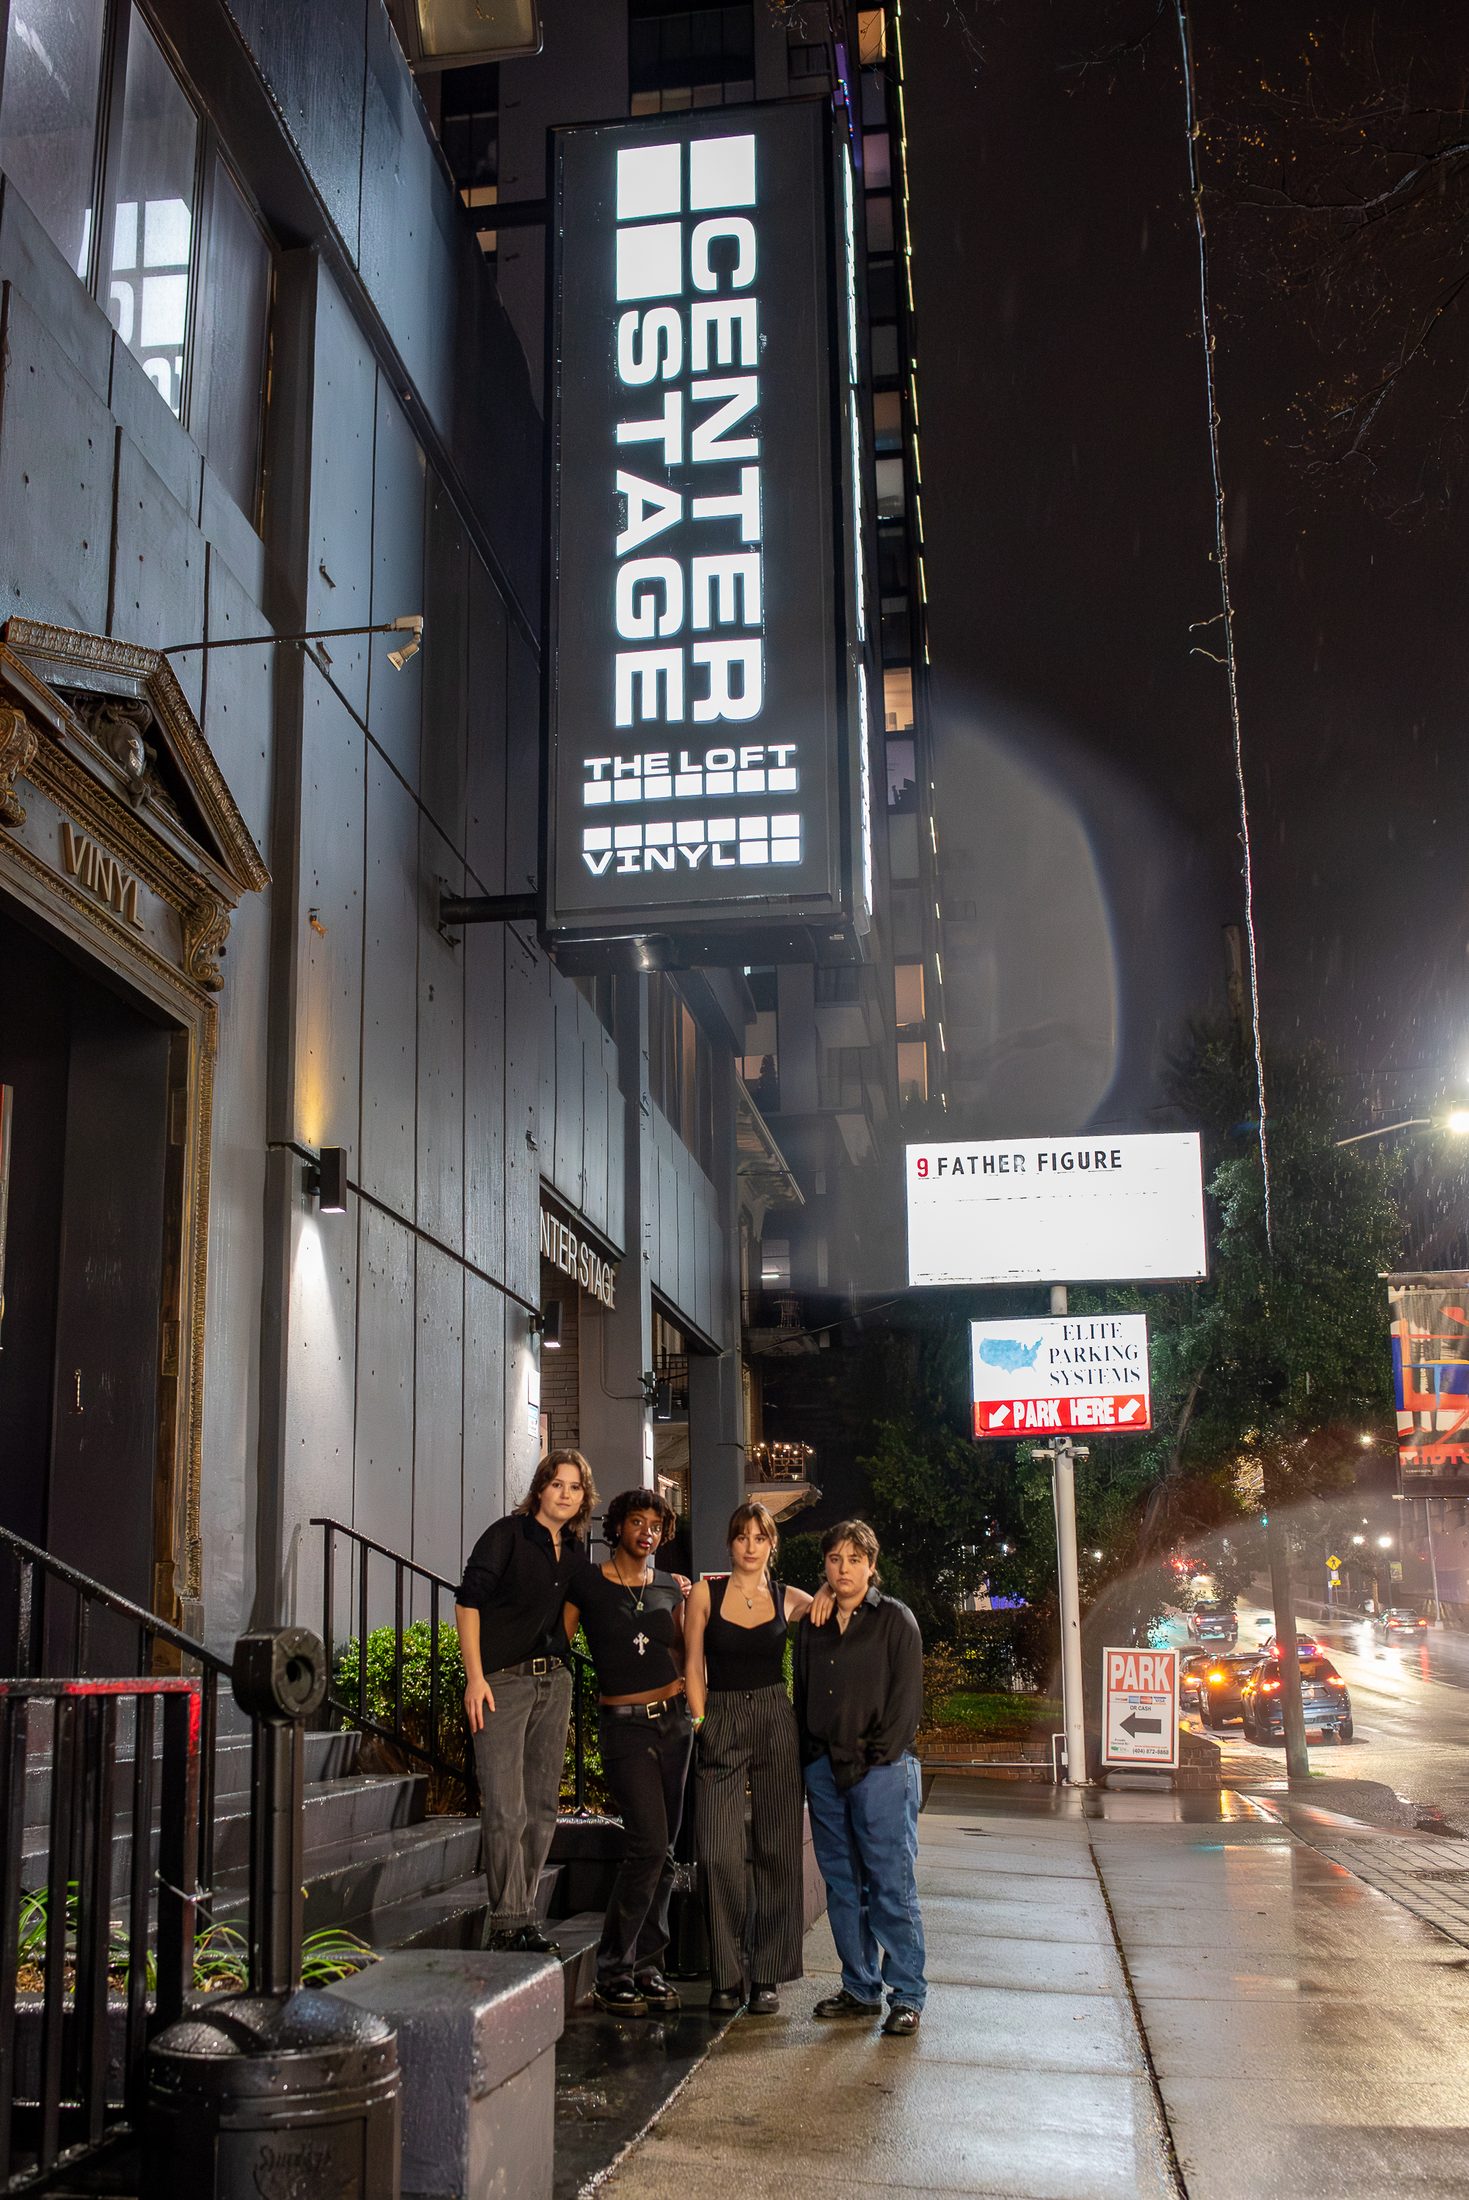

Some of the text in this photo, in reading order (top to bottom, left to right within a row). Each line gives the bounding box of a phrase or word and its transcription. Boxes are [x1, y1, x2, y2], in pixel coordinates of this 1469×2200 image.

[691, 216, 763, 723] CENTER
[615, 306, 684, 728] STAGE
[584, 744, 796, 780] THE LOFT
[582, 843, 736, 875] VINYL
[916, 1150, 1122, 1178] 9 FATHER FIGURE
[540, 1206, 616, 1311] NTER STAGE
[1062, 1322, 1122, 1341] ELITE
[1049, 1344, 1138, 1364] PARKING
[1050, 1367, 1141, 1386] SYSTEMS
[1012, 1397, 1116, 1428] PARK HERE
[1110, 1655, 1171, 1691] PARK
